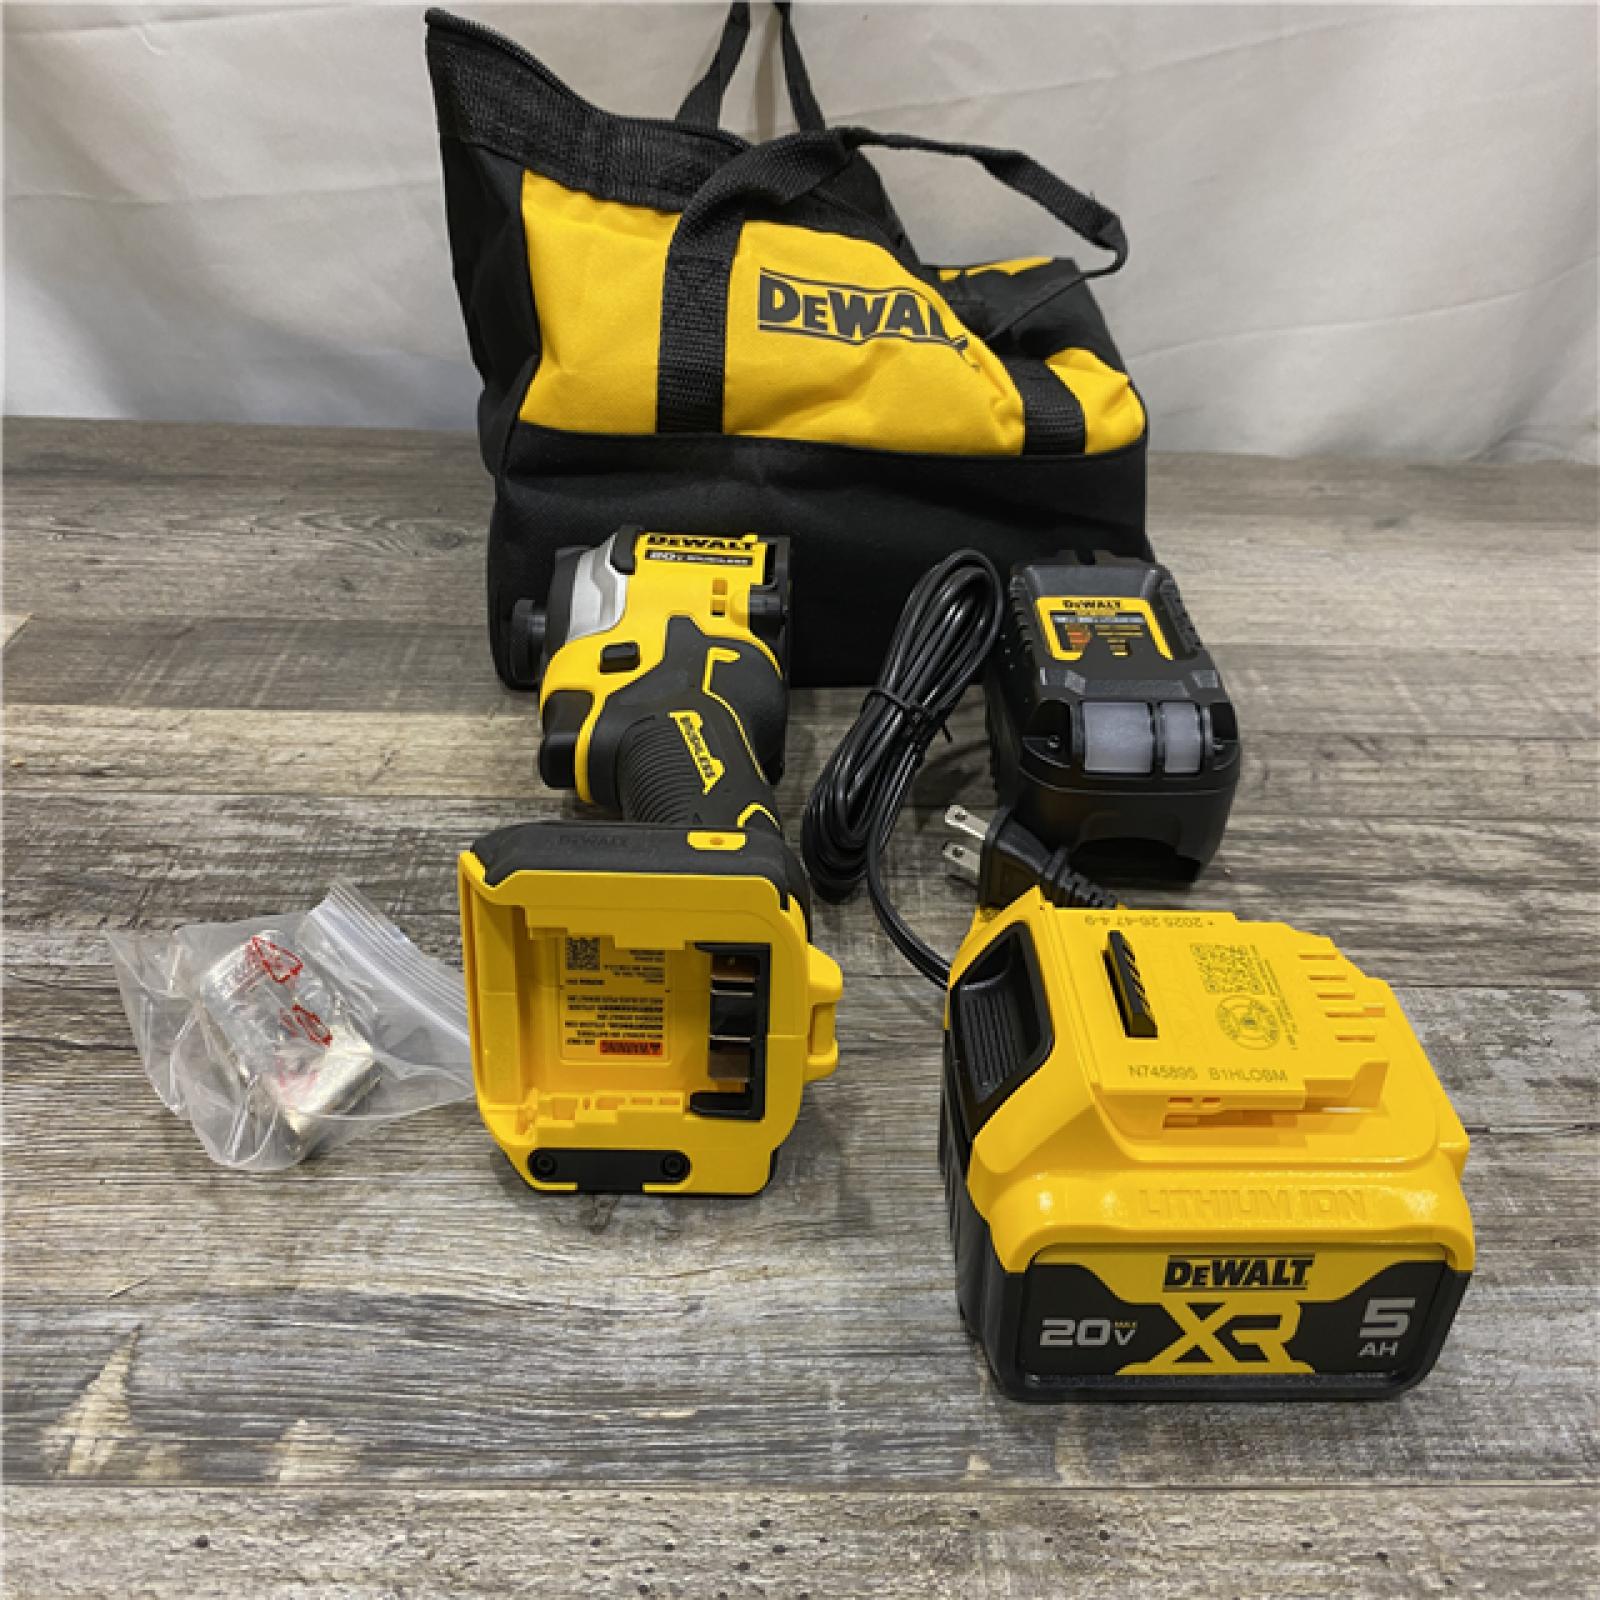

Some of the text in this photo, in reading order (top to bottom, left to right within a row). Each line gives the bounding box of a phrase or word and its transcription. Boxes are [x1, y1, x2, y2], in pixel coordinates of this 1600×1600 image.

[647, 533, 756, 551] DEWALT
[1063, 598, 1121, 609] DEWALT
[1138, 1188, 1367, 1220] LITHIUM ION
[1164, 1258, 1315, 1287] DEWALT
[1359, 1297, 1416, 1338] 5
[1114, 1299, 1314, 1375] XR
[1358, 1341, 1399, 1357] AH
